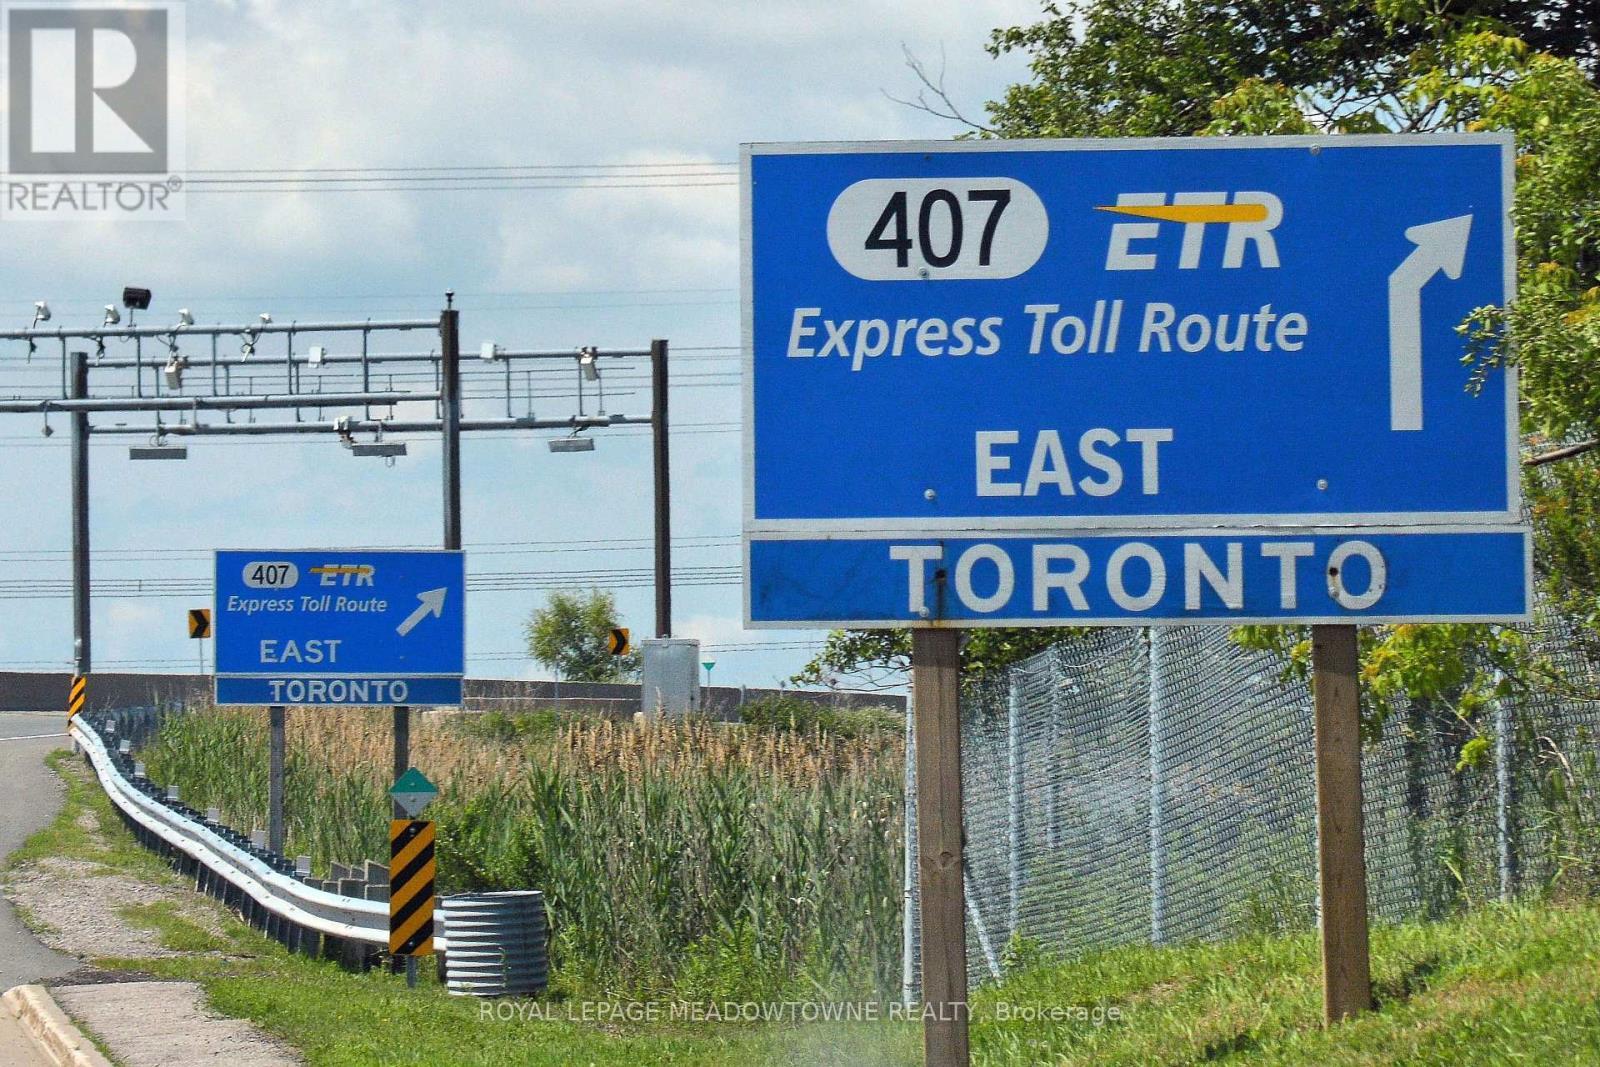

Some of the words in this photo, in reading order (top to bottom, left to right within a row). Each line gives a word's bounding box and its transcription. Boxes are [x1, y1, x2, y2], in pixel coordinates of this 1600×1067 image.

[864, 189, 1011, 268] 407
[1104, 191, 1284, 269] ETR
[787, 306, 1002, 371] Express
[1024, 299, 1122, 355] Toll
[1139, 302, 1309, 354] Route
[975, 427, 1173, 497] EAST
[251, 565, 290, 585] 407
[319, 564, 376, 587] ETR
[889, 540, 1387, 614] TORONTO
[226, 596, 294, 616] Express
[300, 595, 329, 612] Toll
[334, 596, 388, 613] Route
[259, 639, 342, 664] EAST
[268, 680, 409, 703] TORONTO
